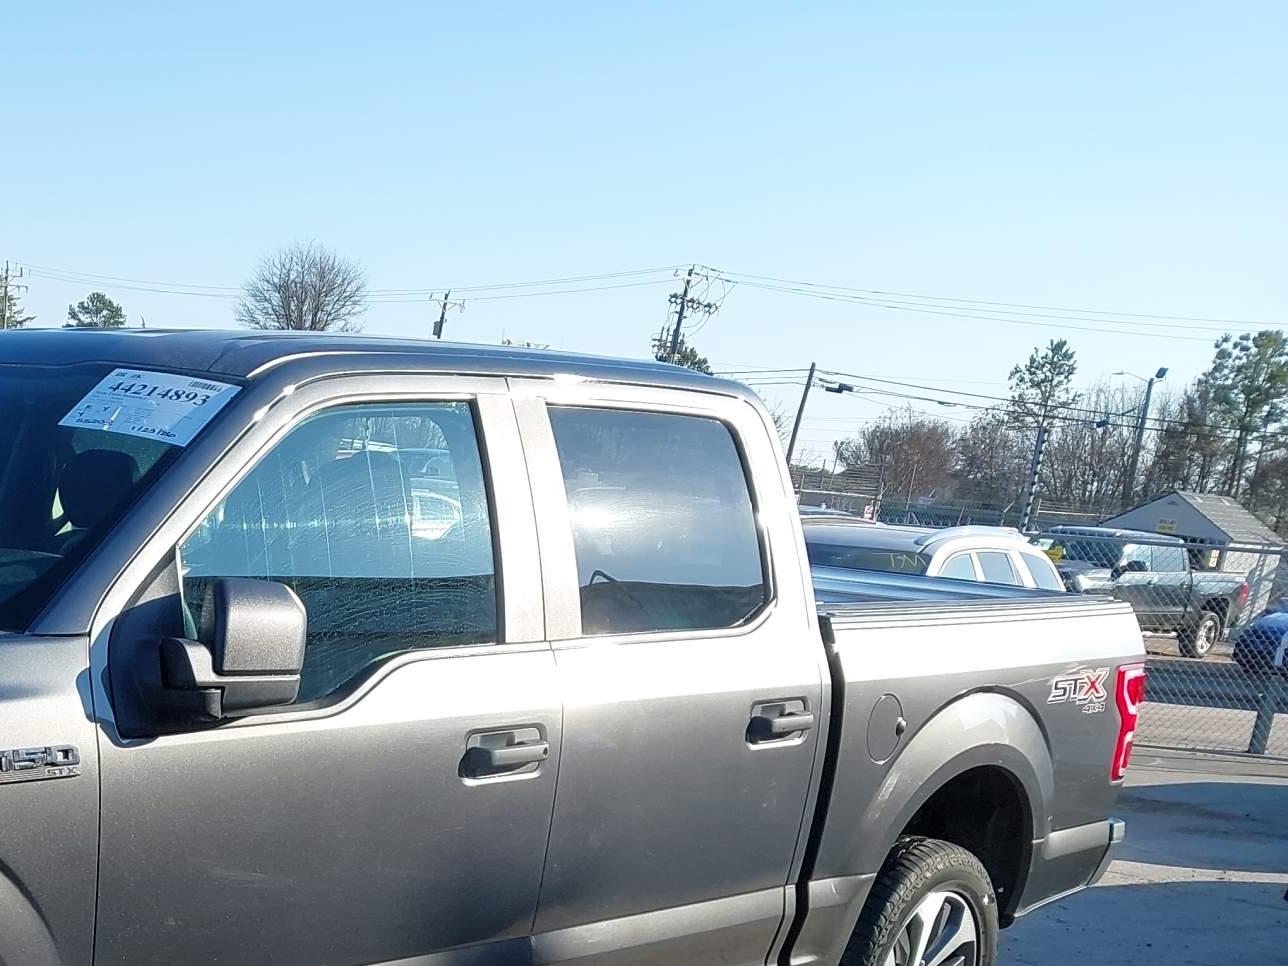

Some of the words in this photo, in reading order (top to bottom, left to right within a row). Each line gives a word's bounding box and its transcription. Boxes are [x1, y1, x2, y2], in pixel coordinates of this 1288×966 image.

[108, 381, 210, 406] 44214893
[1047, 667, 1110, 705] STX
[46, 766, 79, 777] STX
